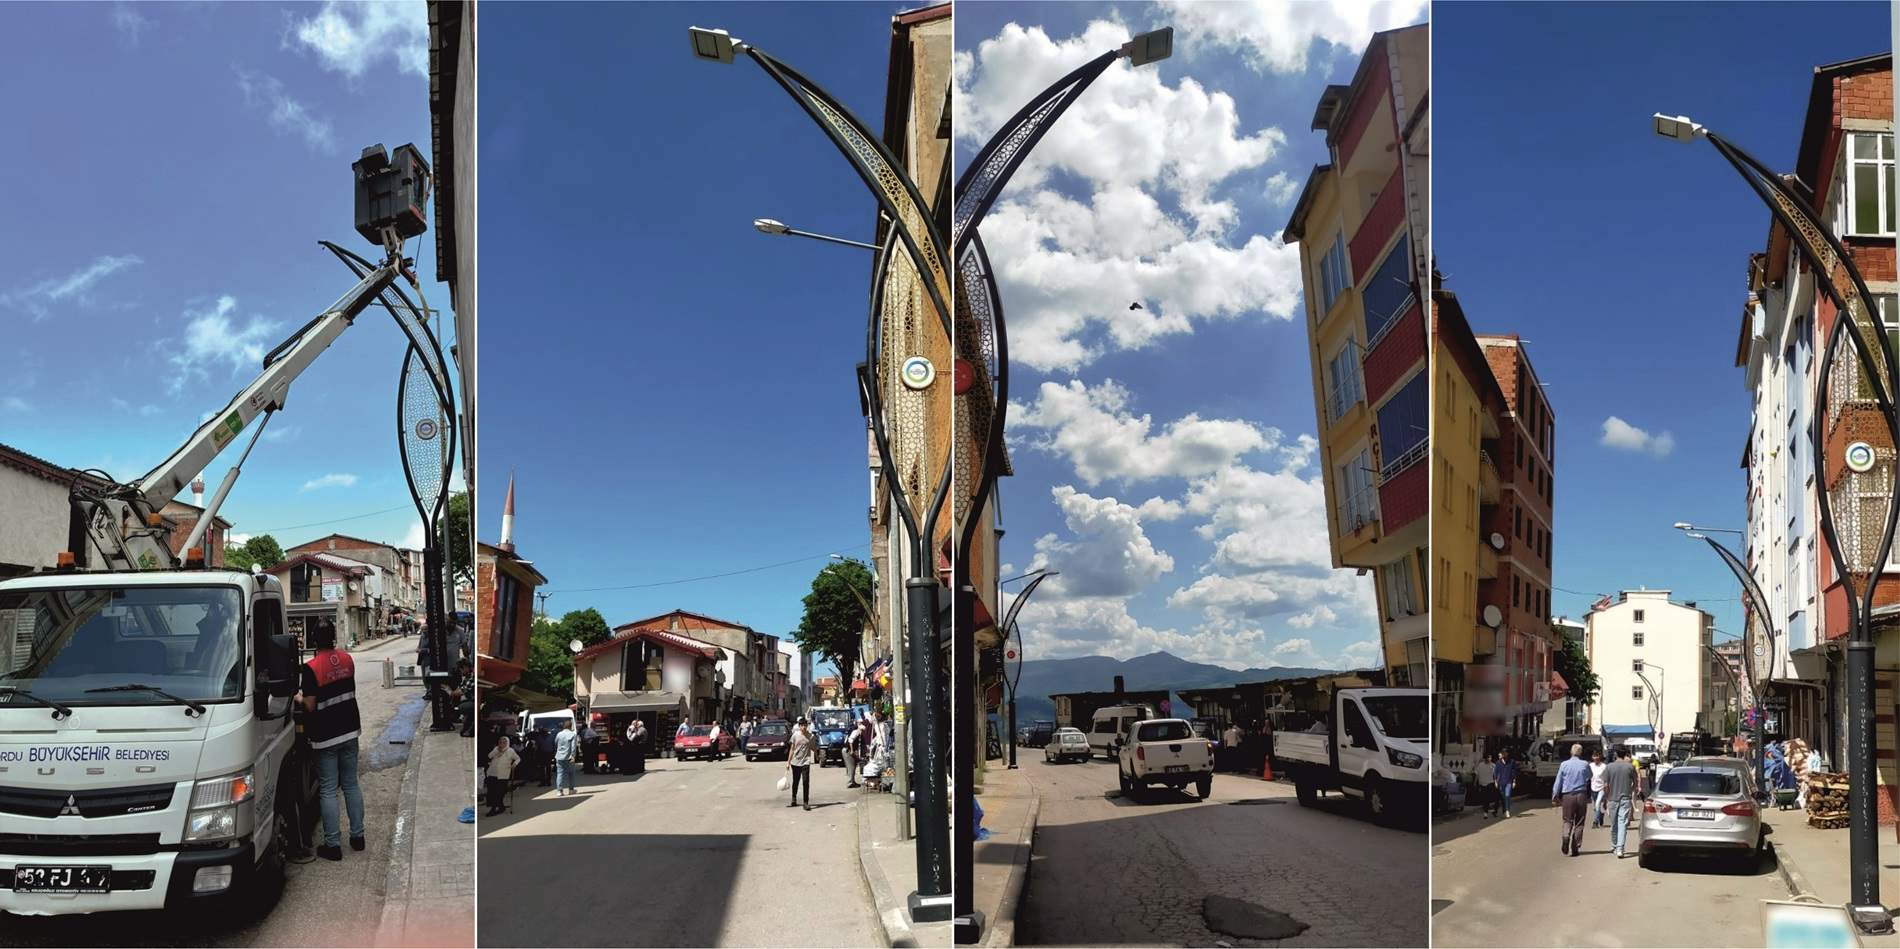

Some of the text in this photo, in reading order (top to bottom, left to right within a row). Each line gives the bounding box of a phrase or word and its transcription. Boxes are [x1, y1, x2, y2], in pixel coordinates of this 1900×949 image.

[0, 746, 170, 762] RDU BÜYÜKŞEHİR BELEDİYESİ
